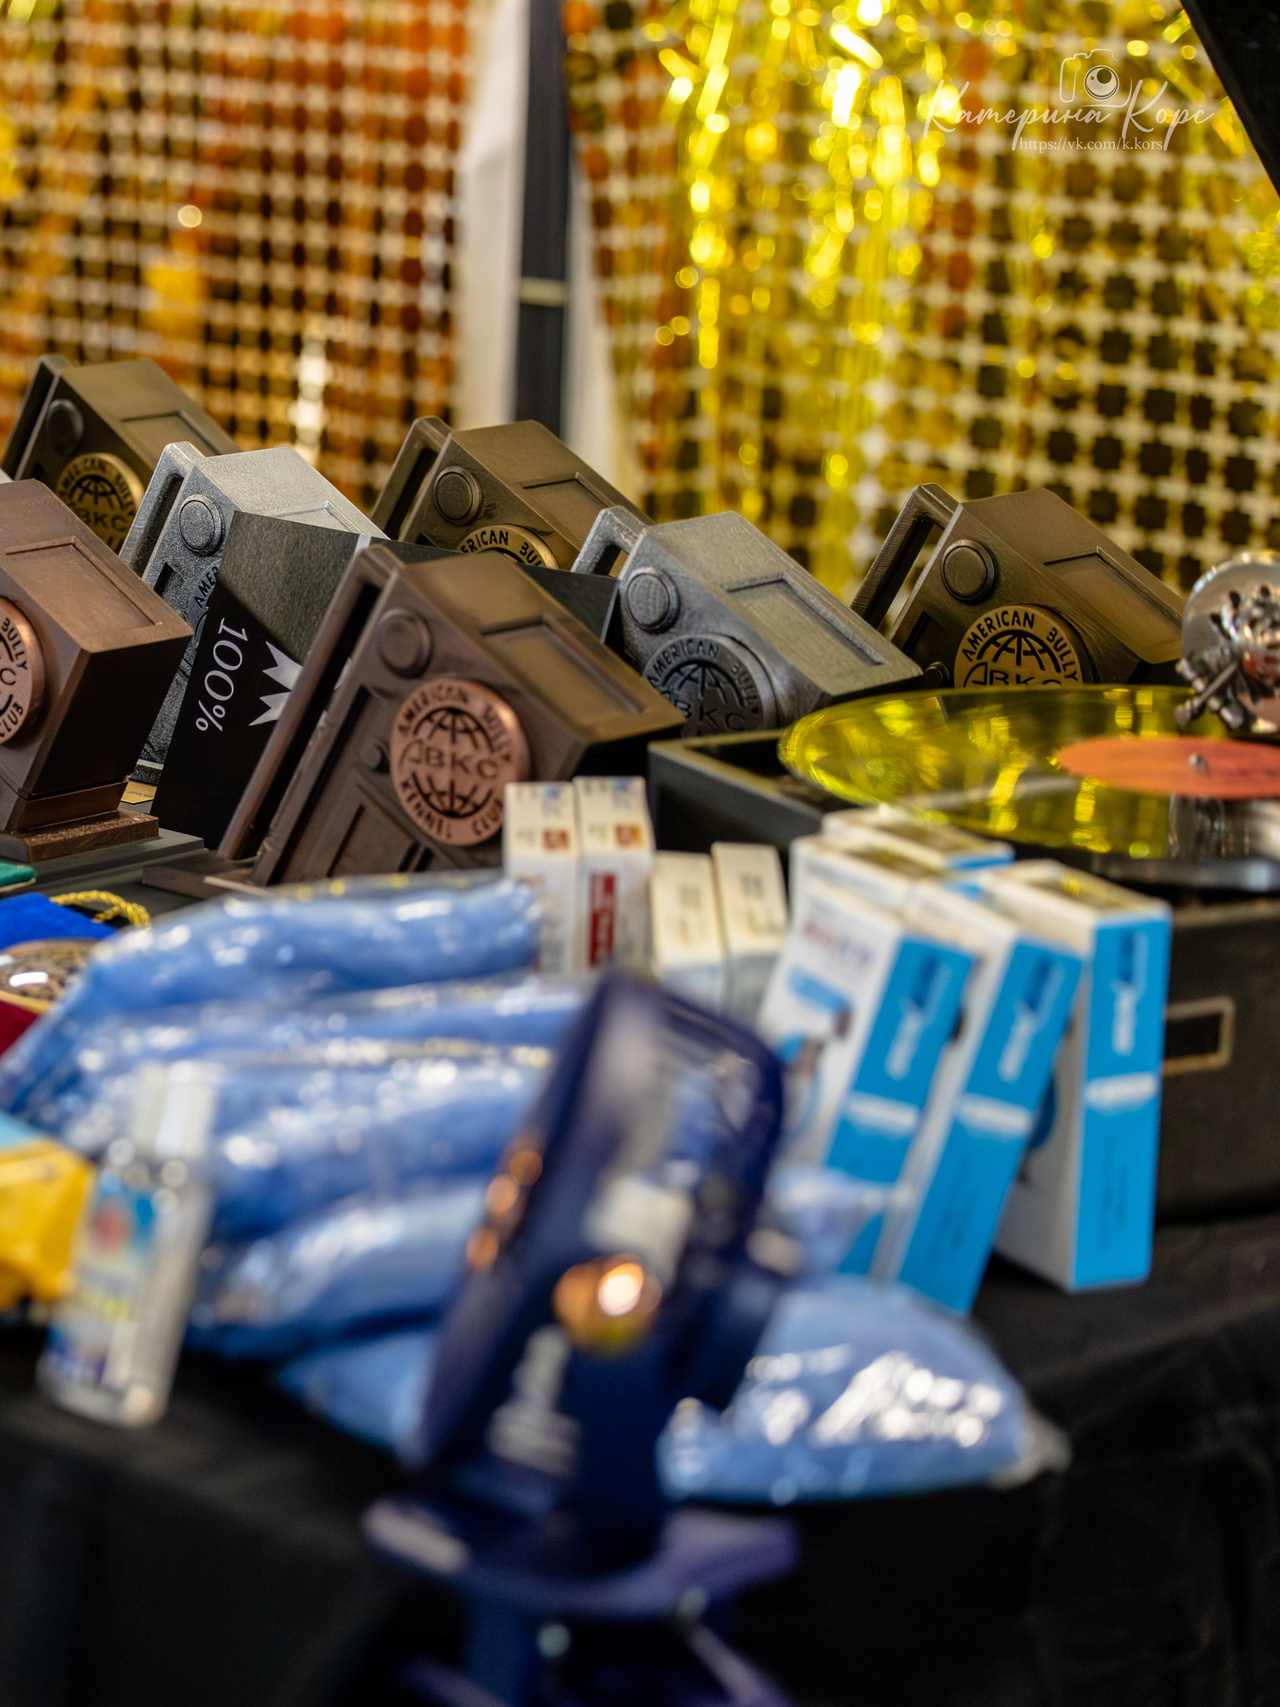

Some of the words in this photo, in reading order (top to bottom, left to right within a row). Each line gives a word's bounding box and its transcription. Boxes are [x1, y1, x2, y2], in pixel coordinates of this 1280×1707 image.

[460, 529, 509, 554] ERICAN
[1, 617, 28, 671] BULLY
[646, 638, 720, 688] AMERICAN
[961, 609, 1035, 662] AMERICAN
[1046, 627, 1079, 682] BULLY
[195, 617, 248, 732] 100%
